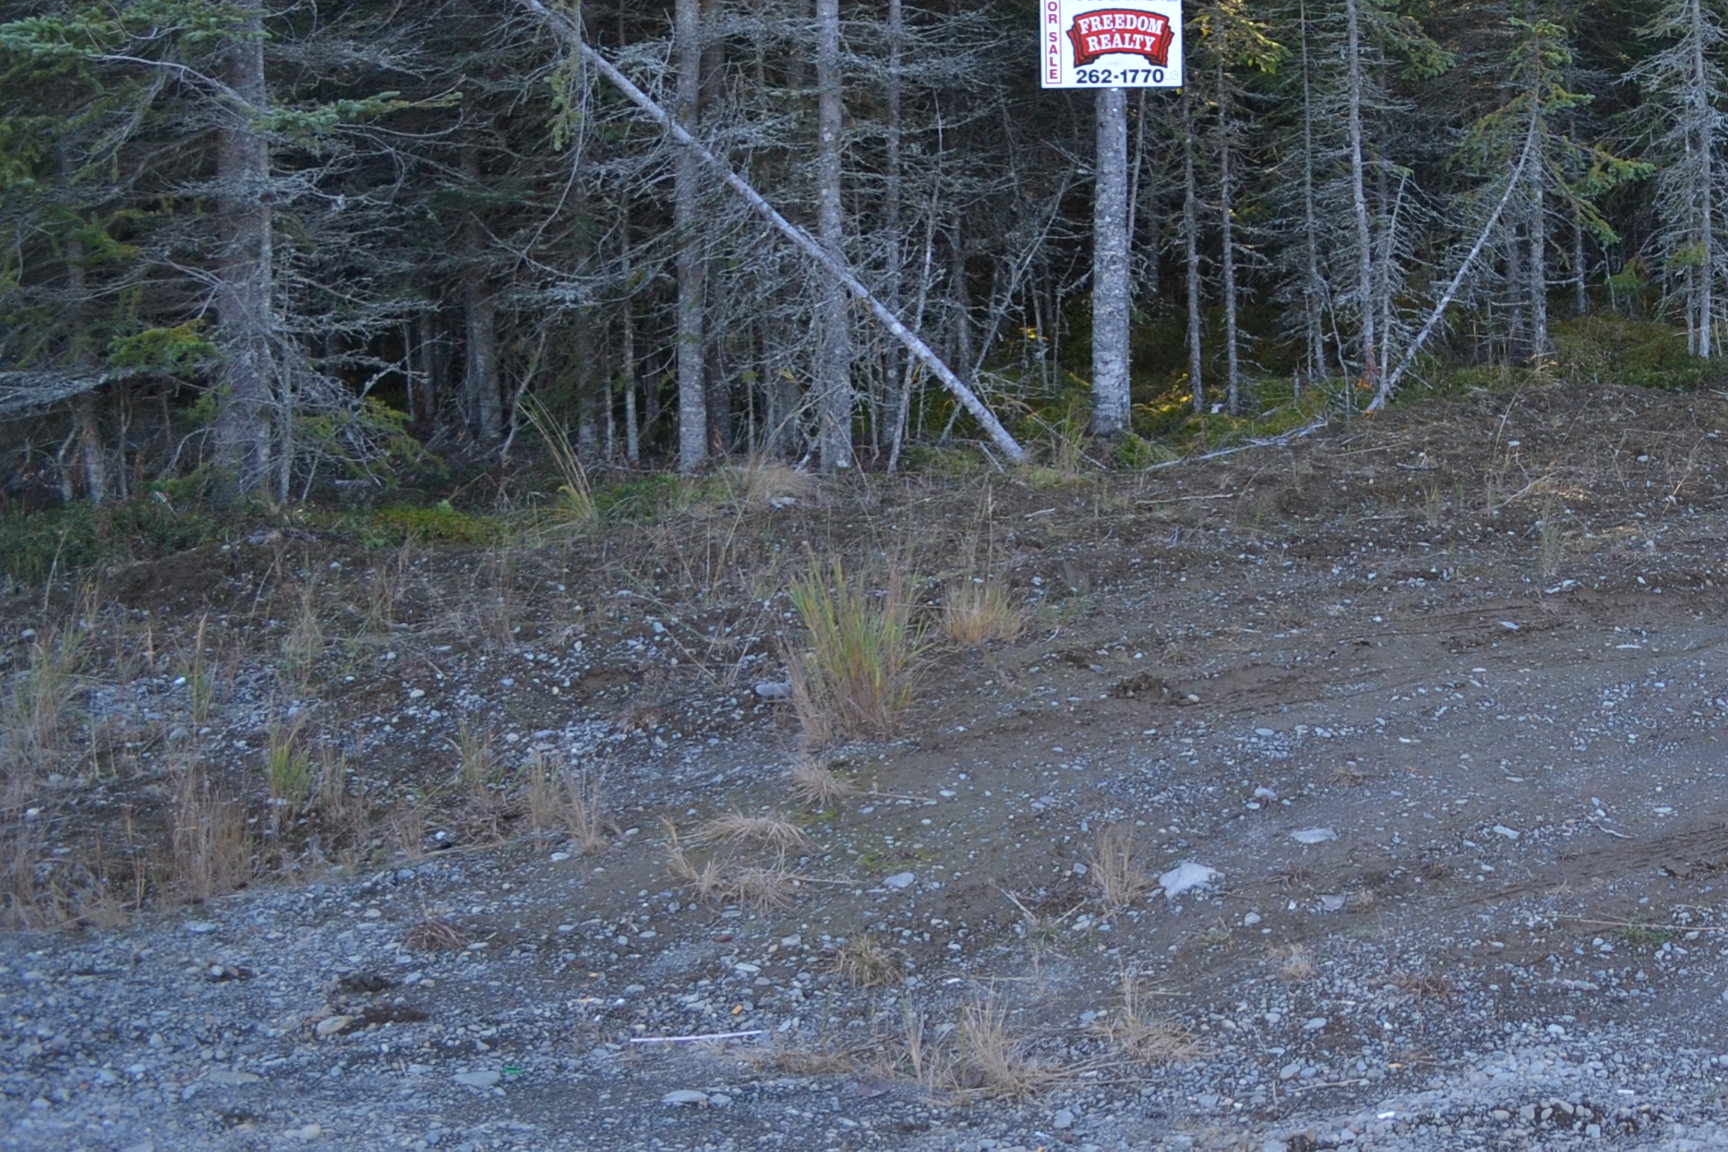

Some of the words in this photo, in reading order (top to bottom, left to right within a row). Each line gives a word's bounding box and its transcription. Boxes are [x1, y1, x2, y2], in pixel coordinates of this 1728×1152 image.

[1078, 14, 1164, 35] FREEDOM
[1086, 33, 1156, 52] REALTY
[1048, 31, 1058, 79] SALE
[1076, 69, 1164, 84] 262-1770
